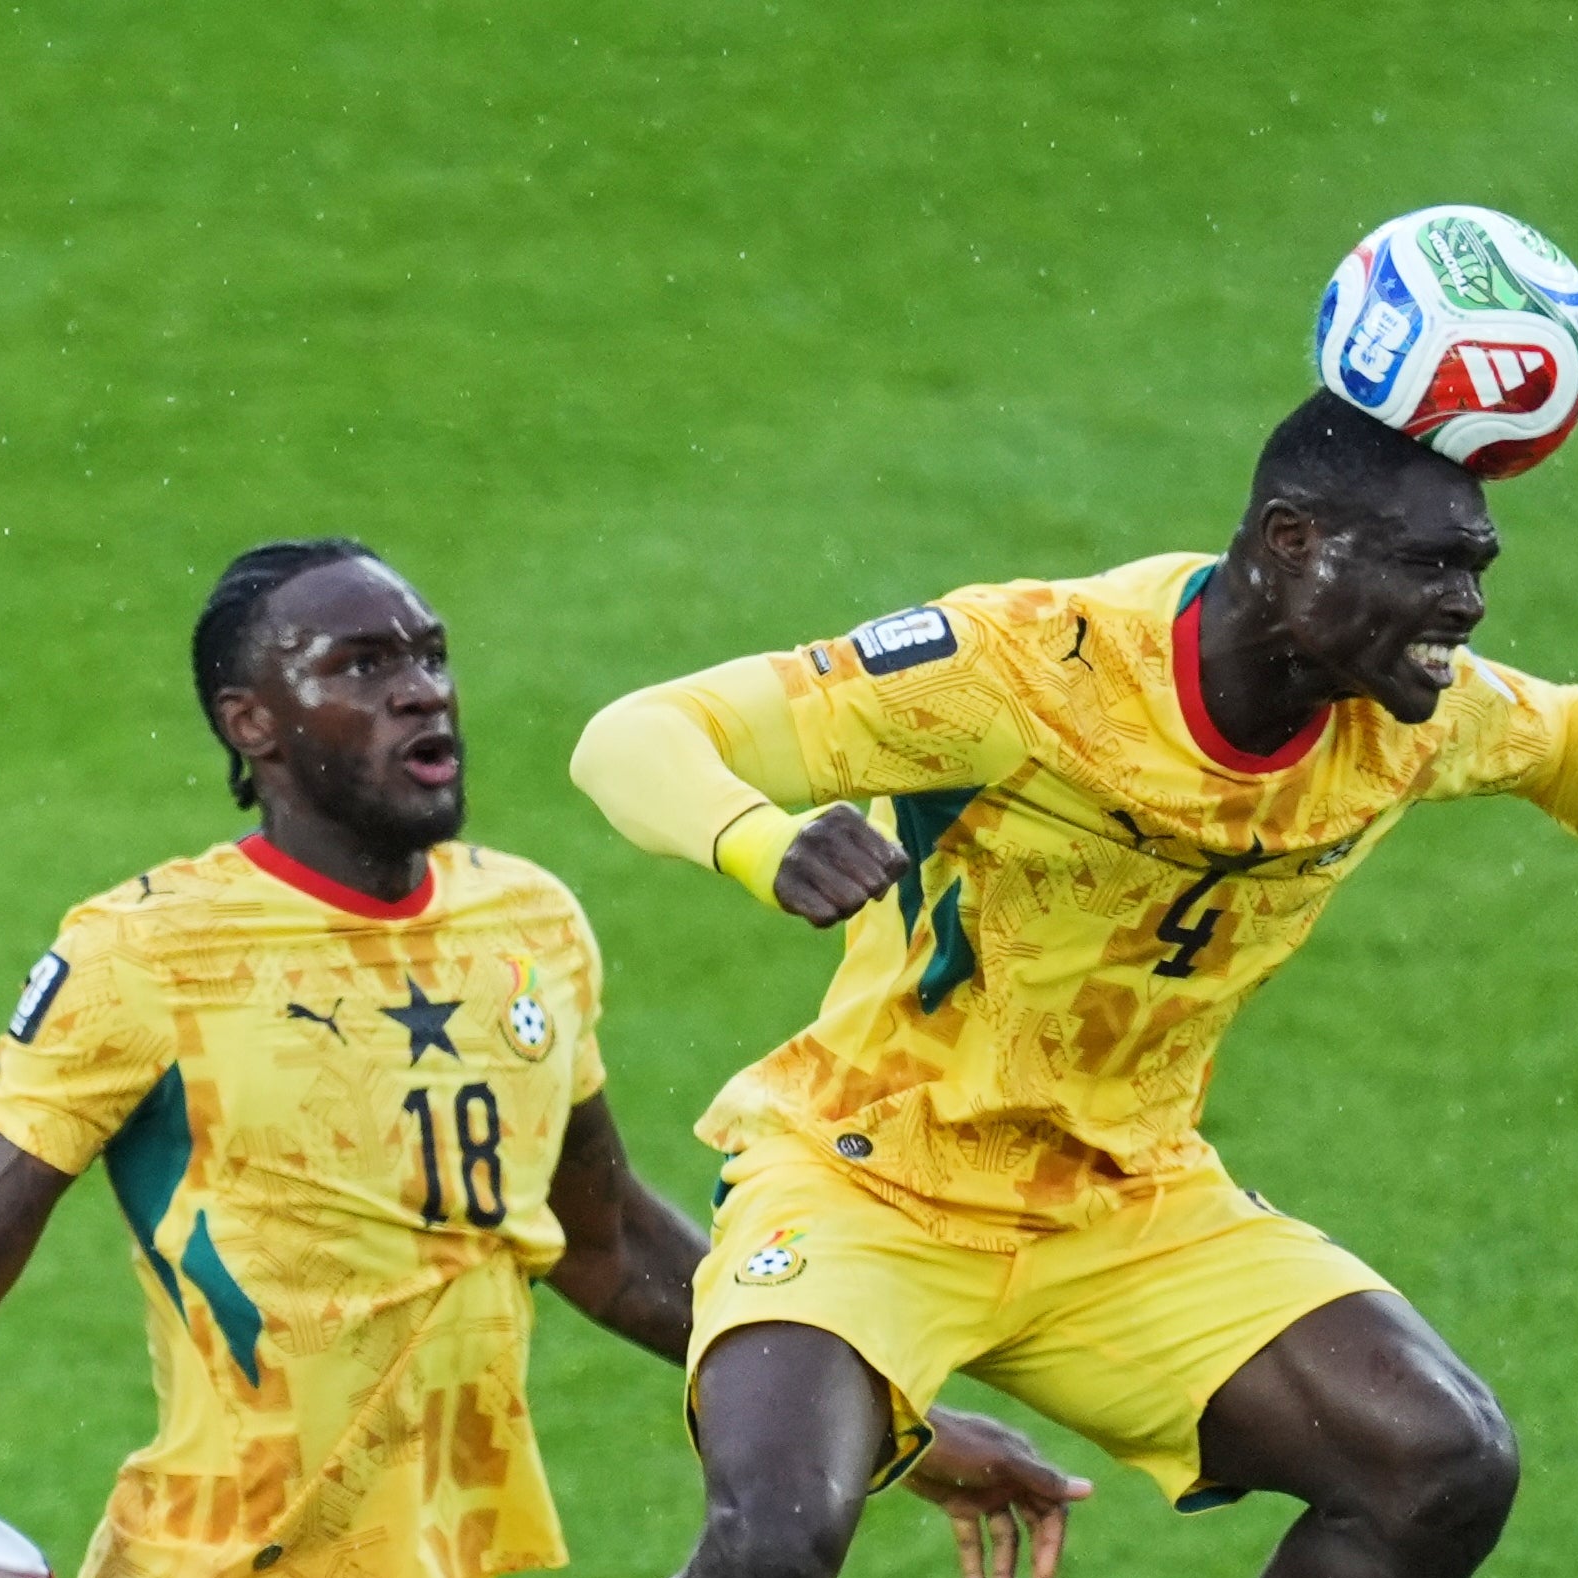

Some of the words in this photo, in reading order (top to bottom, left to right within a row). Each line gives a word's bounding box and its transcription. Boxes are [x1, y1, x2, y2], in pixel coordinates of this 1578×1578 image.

[1427, 230, 1470, 297] TRIONDA
[1152, 869, 1225, 979] 4
[403, 1082, 507, 1228] 18
